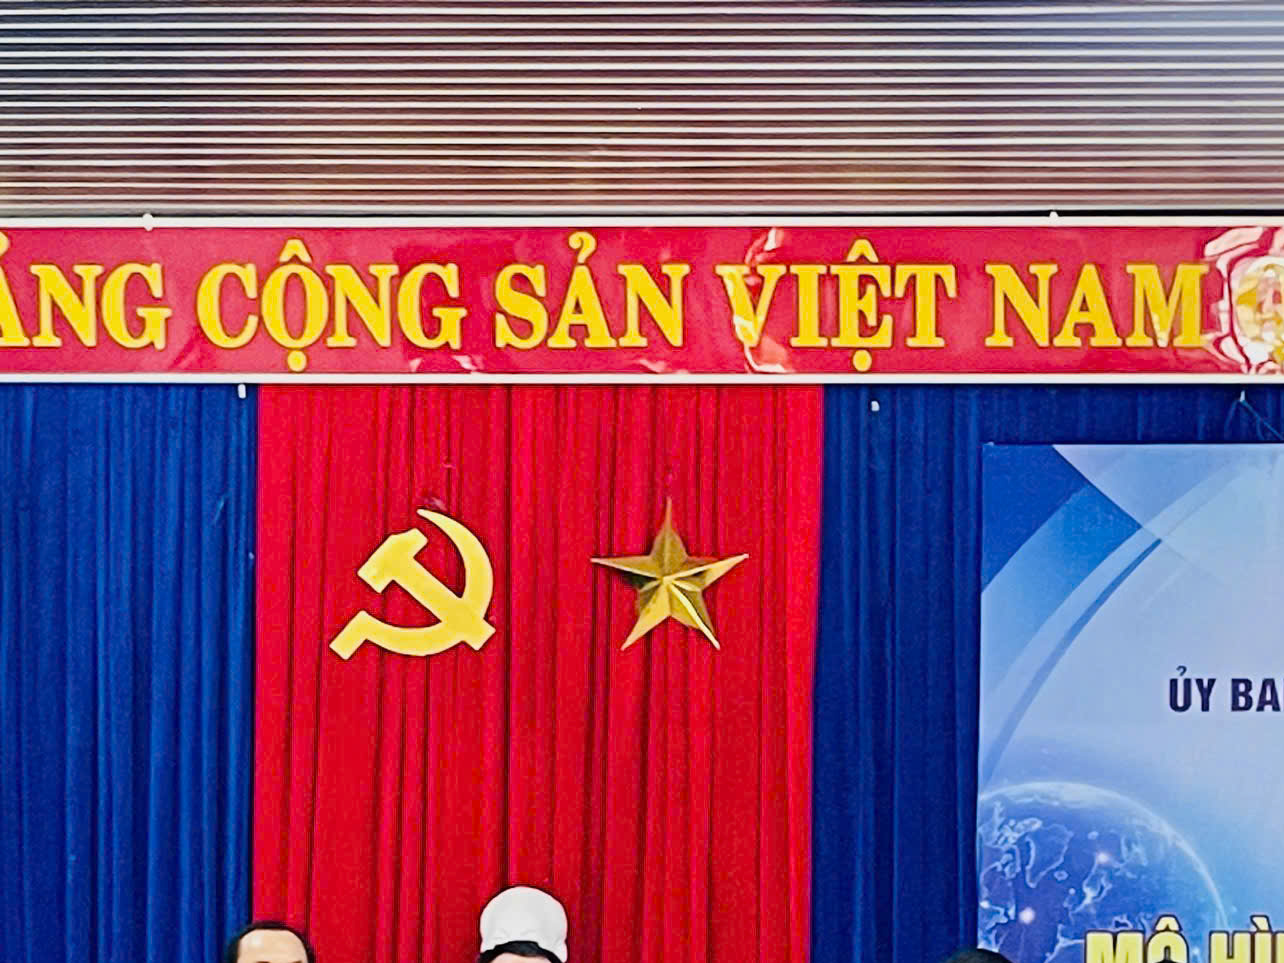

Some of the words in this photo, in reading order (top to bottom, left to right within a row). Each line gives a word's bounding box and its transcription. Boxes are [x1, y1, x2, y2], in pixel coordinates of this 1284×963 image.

[195, 238, 468, 372] CỘNG
[494, 230, 689, 348] SẢN
[716, 238, 957, 372] VIỆT
[985, 263, 1209, 348] NAM
[1169, 665, 1217, 713] ỦY
